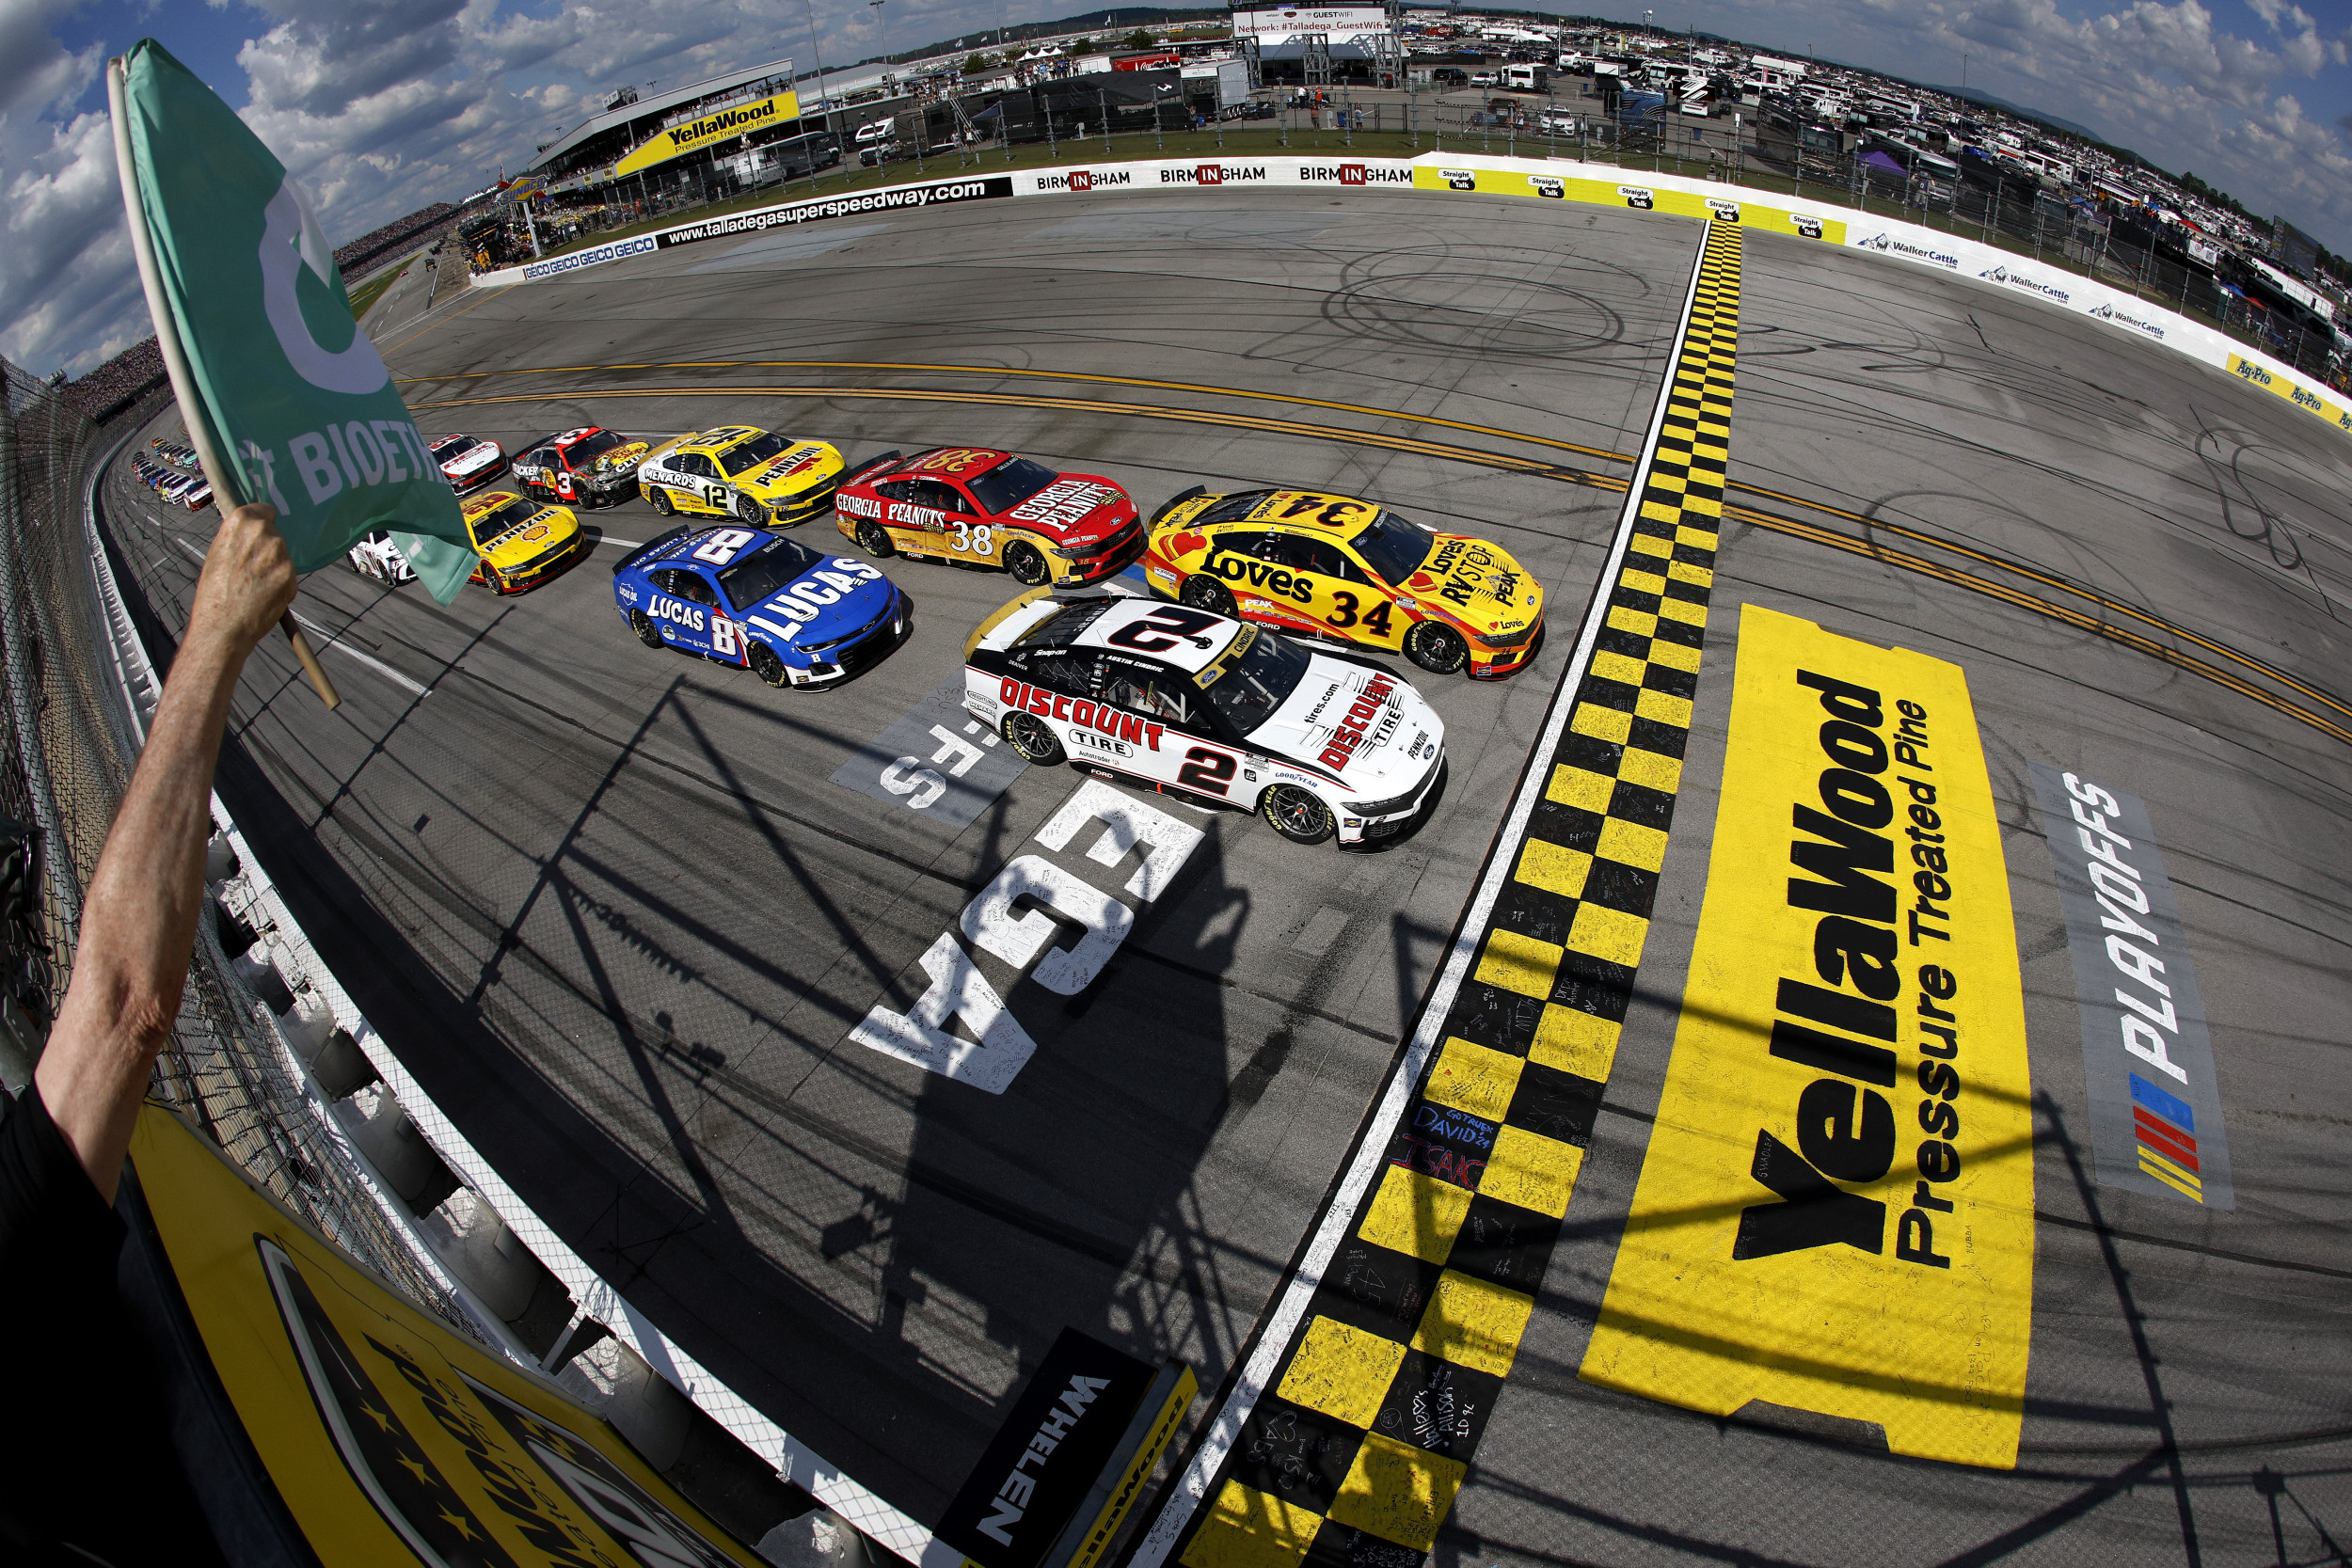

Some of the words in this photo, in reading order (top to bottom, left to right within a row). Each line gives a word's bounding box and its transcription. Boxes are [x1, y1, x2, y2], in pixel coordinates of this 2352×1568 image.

[1238, 24, 1279, 33] Network:
[1281, 21, 1383, 31] #Talladega_GuestWifi
[667, 100, 775, 146] YellaWood
[675, 134, 717, 153] Pressure
[718, 123, 755, 138] Treated
[756, 116, 776, 128] Pine
[501, 177, 544, 204] SUNOCO
[1442, 170, 1470, 179] Straight
[1454, 181, 1470, 189] Talk
[1532, 177, 1559, 186] Straight
[1544, 188, 1559, 197] Talk
[1622, 187, 1648, 198] Straight
[1632, 198, 1647, 208] Talk
[1709, 200, 1735, 211] Straight
[669, 182, 985, 245] www.talladegasuperspeedway.com
[1720, 213, 1734, 221] Talk
[1793, 215, 1819, 227] Straight
[1804, 228, 1818, 237] Talk
[526, 263, 550, 278] GEICO
[550, 256, 580, 274] GEICO
[580, 246, 613, 266] GEICO
[615, 237, 655, 257] GEICO
[553, 427, 589, 445] 3
[615, 452, 647, 472] CLU
[754, 447, 823, 488] PENNZOIL
[557, 471, 571, 494] 3
[644, 468, 696, 489] MENARDS
[703, 484, 728, 509] 12
[836, 493, 882, 519] GEORGIA
[887, 503, 946, 529] PEANUTS
[1009, 480, 1091, 521] GEORGIA
[1037, 483, 1117, 532] PEANUTS
[1279, 495, 1368, 528] 34
[484, 509, 562, 553] PENNZOIL
[650, 536, 679, 553] LUCAS
[691, 528, 756, 566] 8
[763, 538, 785, 554] BUSCH
[950, 520, 993, 556] 38
[746, 558, 883, 643] LUCAS
[1244, 597, 1276, 610] PEAK
[1494, 569, 1522, 609] PEAK
[646, 594, 705, 632] LUCAS
[1108, 605, 1226, 653] 2
[1255, 621, 1280, 630] FORD
[1325, 590, 1393, 639] 34
[1420, 610, 1461, 624] GOODYEAR
[710, 614, 738, 657] 8
[749, 632, 773, 644] GOODYEAR
[1233, 627, 1256, 653] CINDRIC
[1411, 620, 1434, 652] GOODYEAR
[810, 653, 822, 663] 8
[1106, 655, 1133, 667] AUSTIN
[1133, 661, 1165, 673] CINDRIC
[1452, 652, 1466, 670] EAGLE
[1000, 675, 1168, 752] DISCOUNT
[1304, 683, 1340, 724] tires.com
[1317, 673, 1398, 772] DISCOUNT
[1374, 709, 1402, 742] TIRE
[1894, 697, 1929, 761] Pine
[1006, 720, 1031, 761] GOODYEAR
[1074, 731, 1127, 755] TIRE
[1407, 729, 1429, 761] PENNZOIL
[1079, 750, 1111, 765] Autotrader
[1090, 768, 1114, 779] FORD
[1177, 745, 1238, 797] 2
[1275, 771, 1318, 788] GOODYEAR
[1263, 784, 1282, 831] GOODYEAR
[1324, 805, 1333, 832] EAGLE
[1907, 776, 1950, 946] Treated
[2061, 771, 2188, 1085] PLAYOFFS
[1732, 669, 1897, 1261] YellaWood
[1414, 1106, 1477, 1143] DAVID
[1896, 968, 1959, 1270] Pressure
[1390, 1132, 1487, 1192] ISAAC
[976, 1374, 1112, 1547] WHELEN
[1078, 1395, 1184, 1568] llaWood
